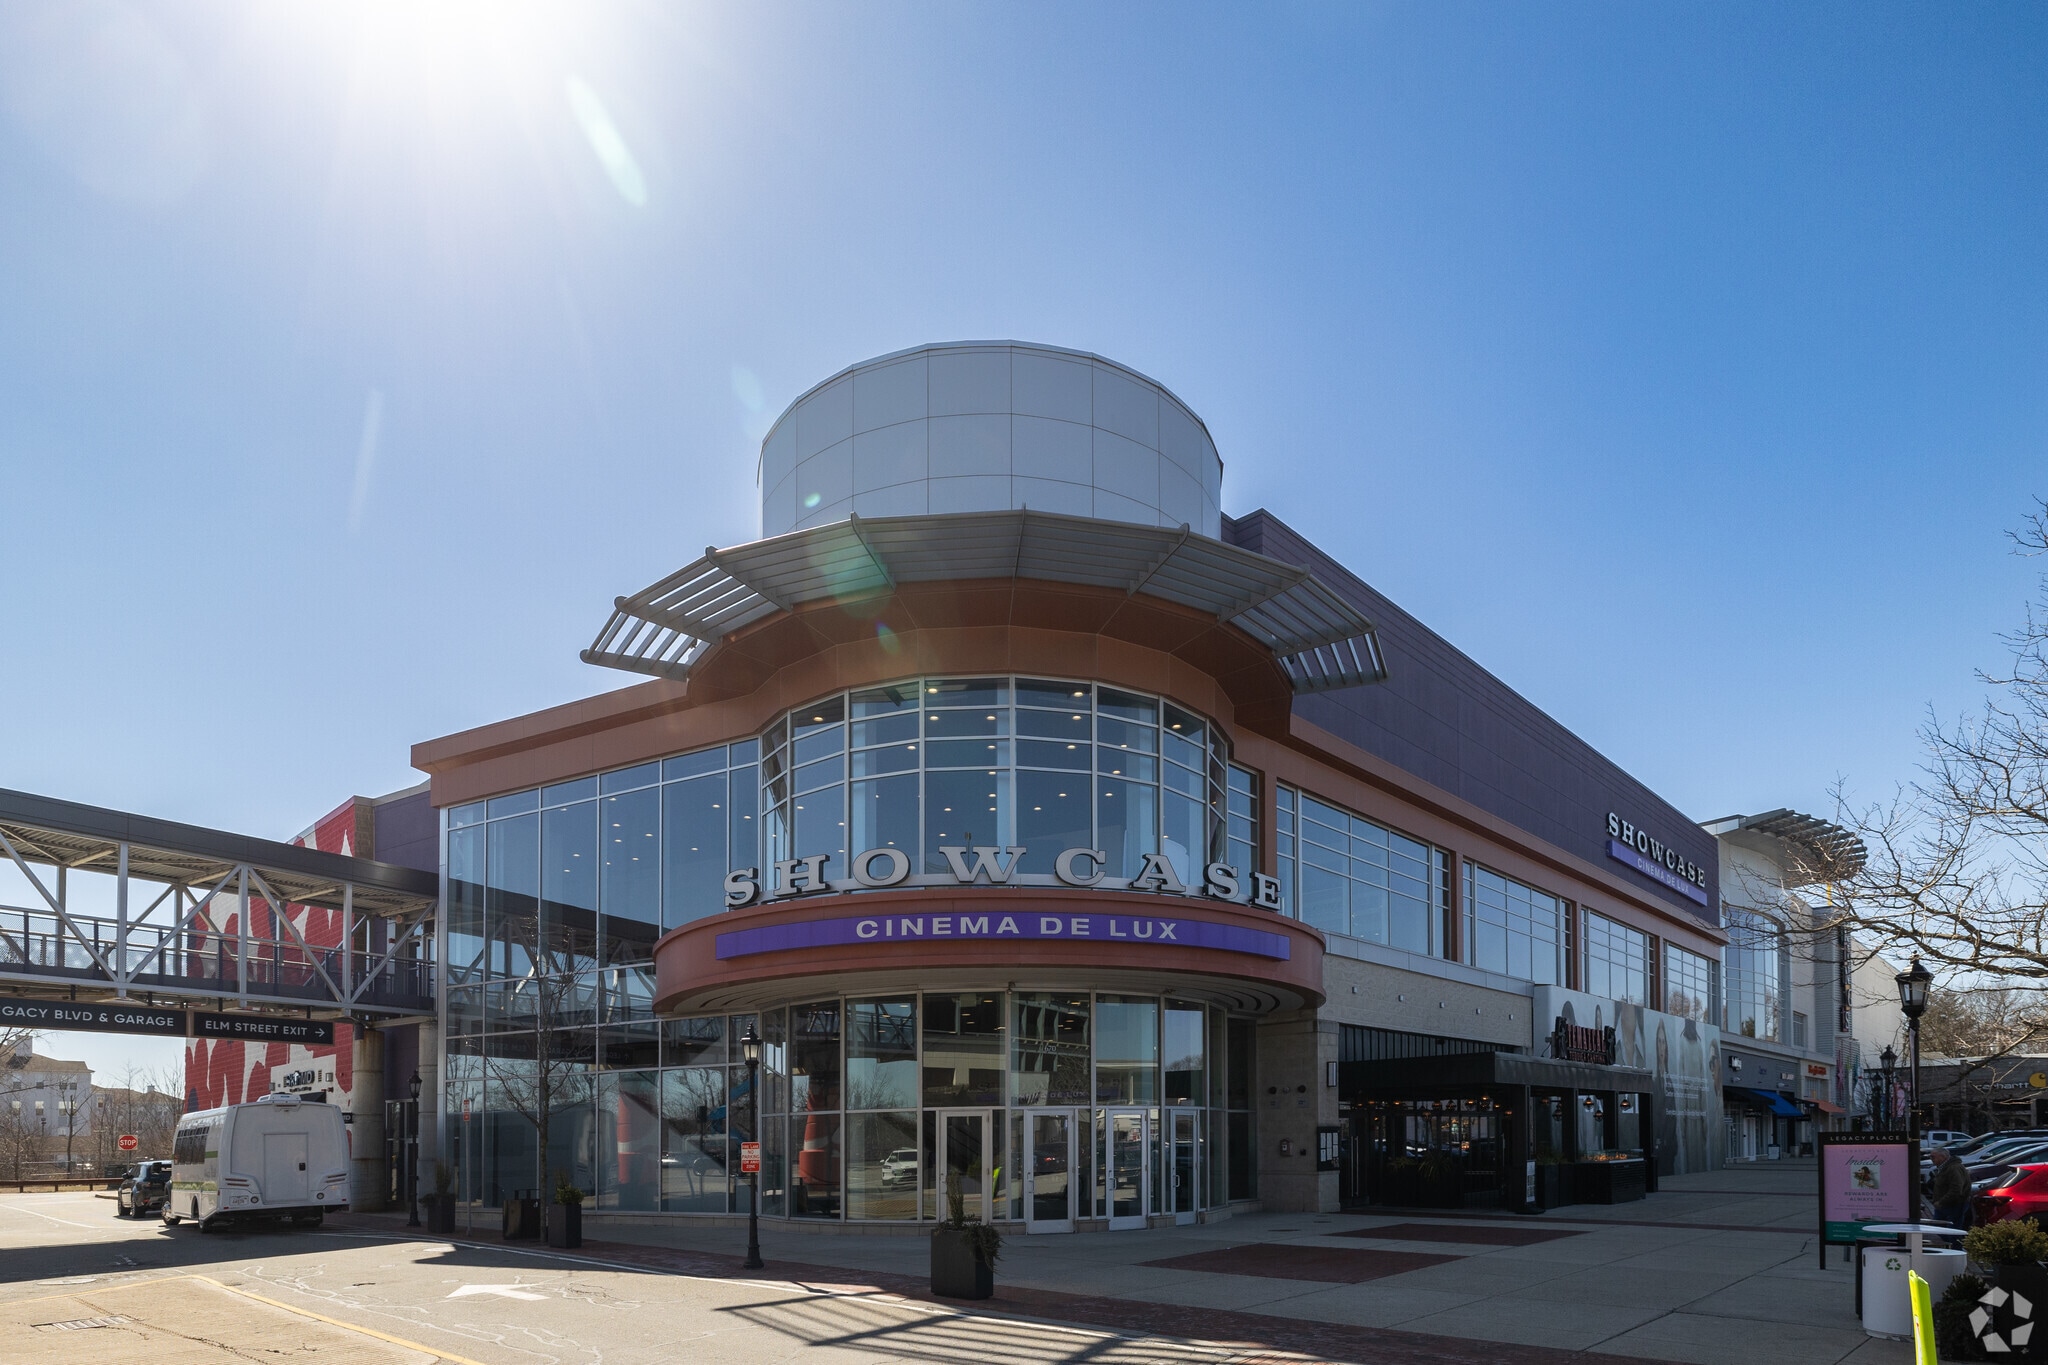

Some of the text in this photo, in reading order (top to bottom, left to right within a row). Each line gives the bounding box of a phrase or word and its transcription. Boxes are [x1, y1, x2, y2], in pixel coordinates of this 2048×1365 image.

[1606, 812, 1706, 888] SHOWCASE
[724, 846, 1281, 911] SHOWCASE
[1637, 858, 1690, 894] CINEMA DE LUX
[856, 916, 1177, 939] CINEMA DE LUX
[54, 1009, 93, 1021] BLVD
[99, 1013, 108, 1023] &
[114, 1014, 174, 1026] GARAGE
[205, 1020, 307, 1036] ELM STREET EXIT
[119, 1139, 137, 1147] STOP
[1845, 1155, 1886, 1166] Insider
